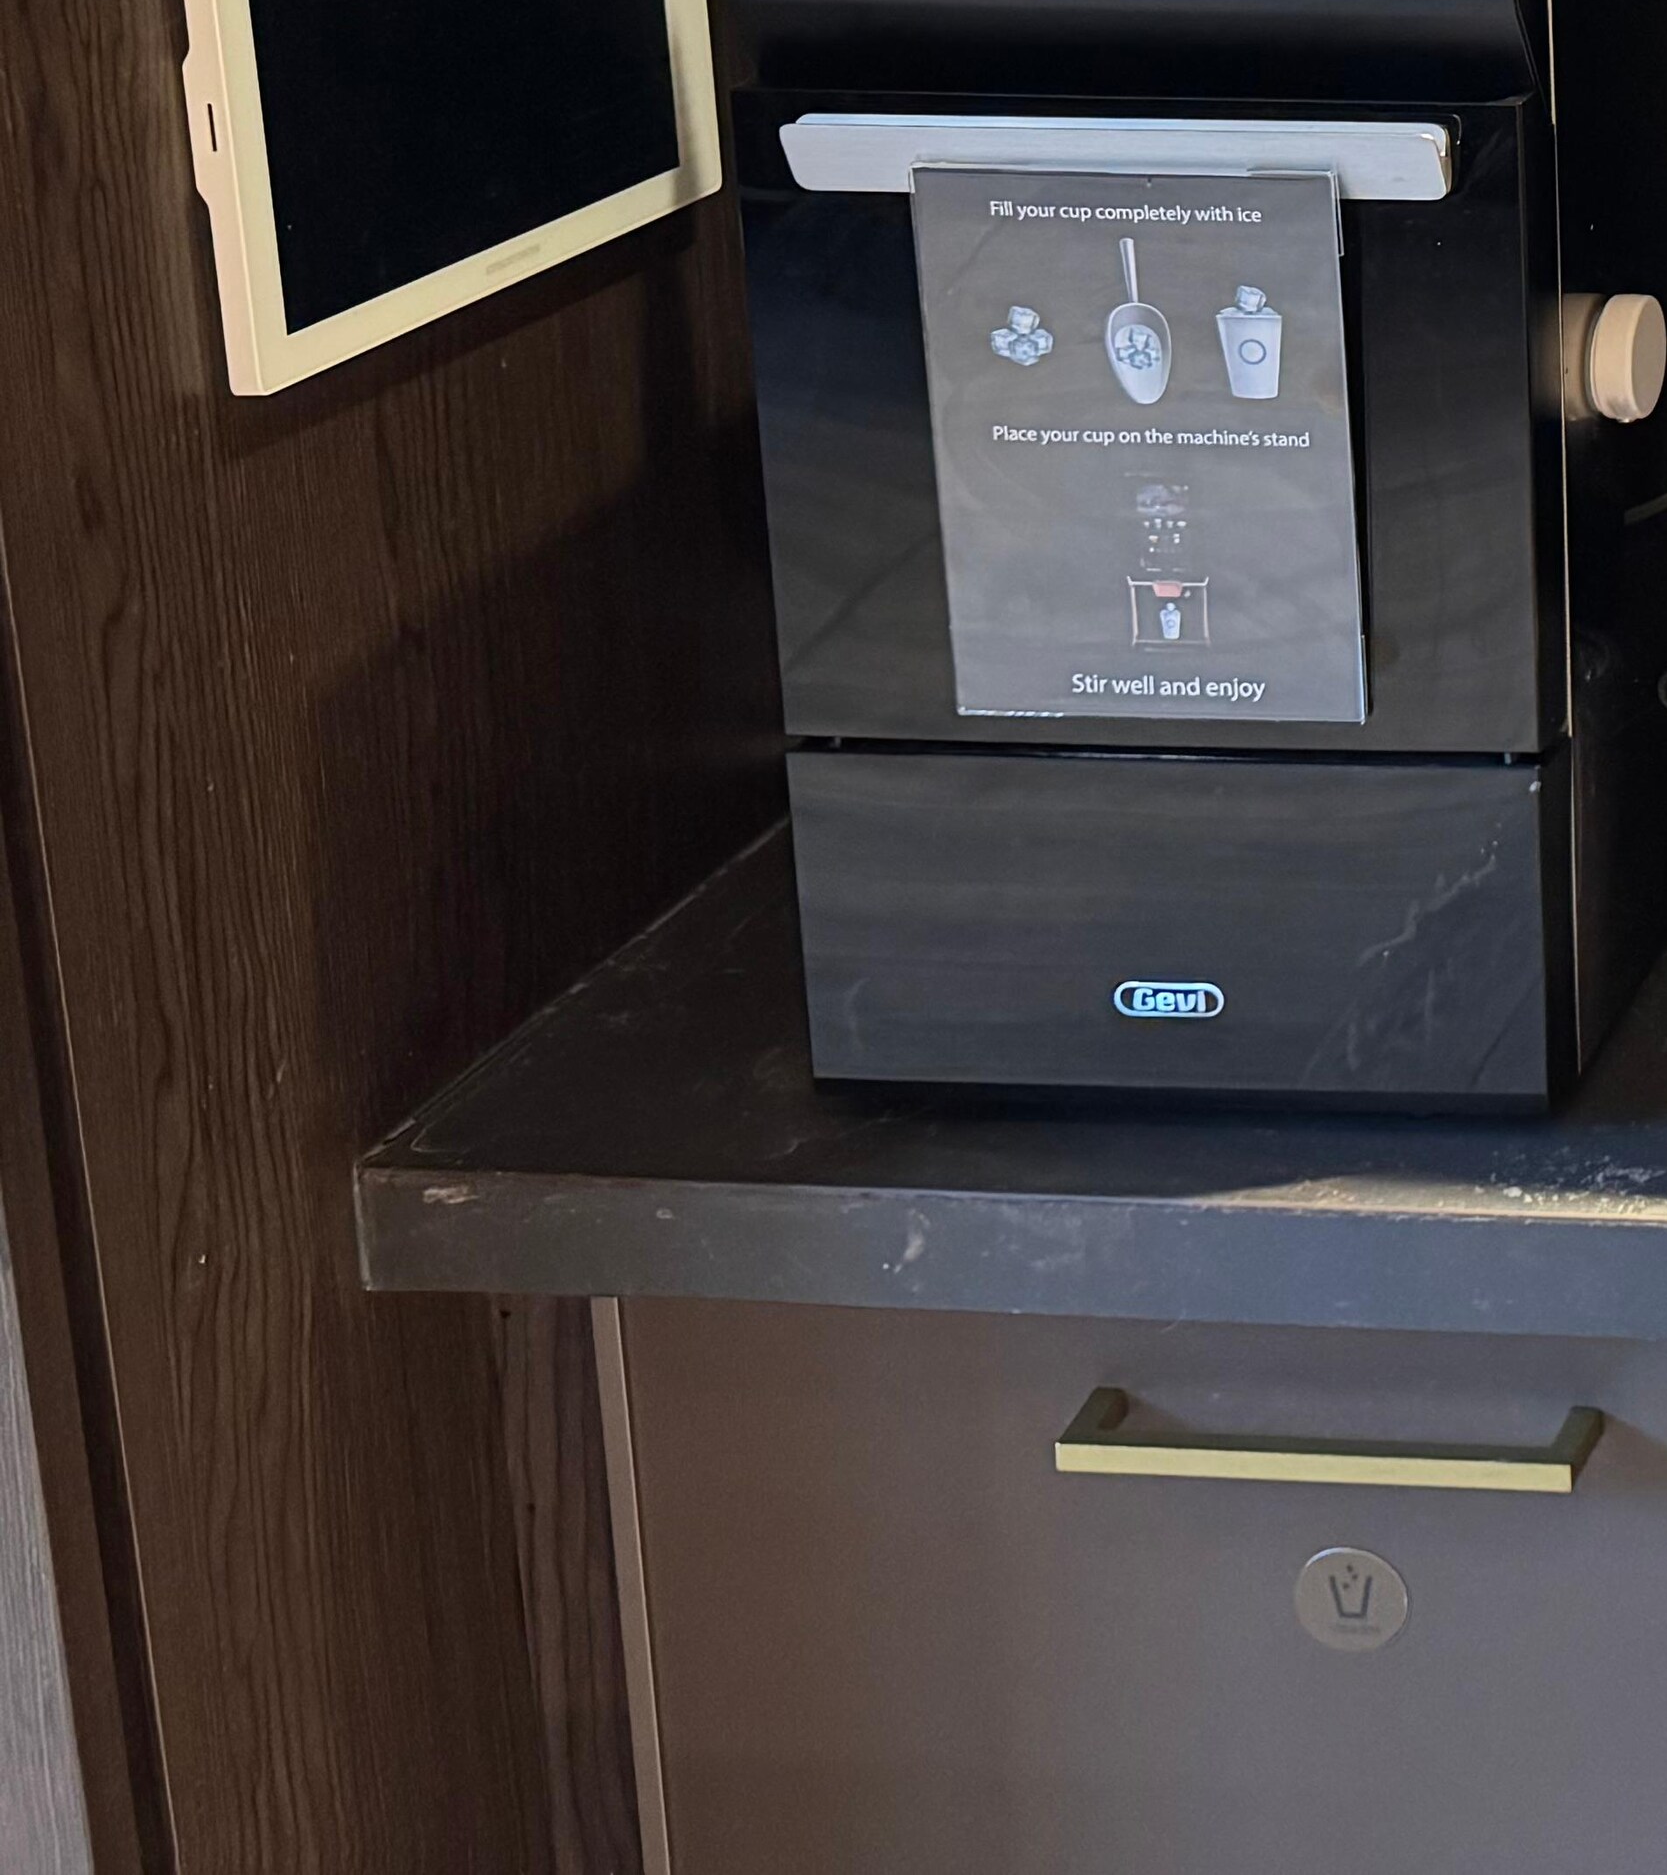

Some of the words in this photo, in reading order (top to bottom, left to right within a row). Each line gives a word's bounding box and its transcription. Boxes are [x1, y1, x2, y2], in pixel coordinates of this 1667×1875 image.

[990, 200, 1014, 217] Fill
[1017, 203, 1056, 220] your
[1060, 206, 1092, 224] cup
[1095, 203, 1191, 225] completely
[1195, 206, 1233, 222] with
[1237, 207, 1262, 223] ice
[993, 426, 1038, 442] Place
[1041, 429, 1080, 445] your
[1083, 430, 1114, 446] cup
[1118, 430, 1141, 444] on
[1145, 429, 1173, 445] the
[1264, 432, 1310, 447] stand
[1072, 674, 1108, 693] Stir
[1112, 676, 1155, 695] well
[1160, 676, 1200, 696] and
[1206, 678, 1265, 701] enjoy
